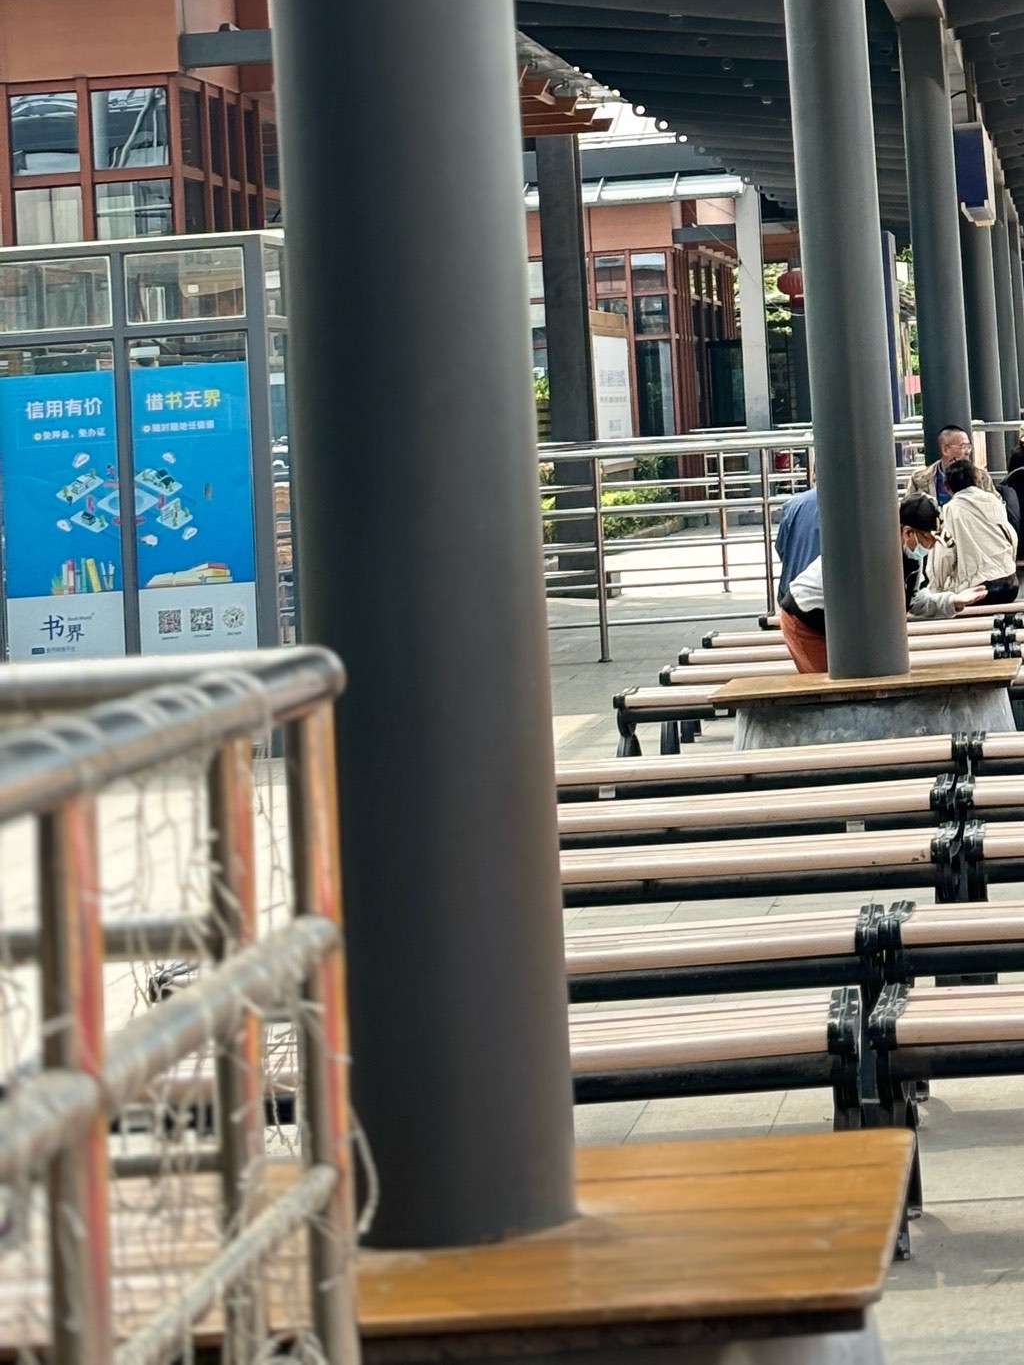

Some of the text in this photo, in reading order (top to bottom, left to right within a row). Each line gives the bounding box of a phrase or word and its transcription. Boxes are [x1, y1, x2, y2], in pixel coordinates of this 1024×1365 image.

[25, 397, 103, 419] 信用有价
[146, 389, 221, 411] 借书无界
[40, 614, 85, 643] 书界
